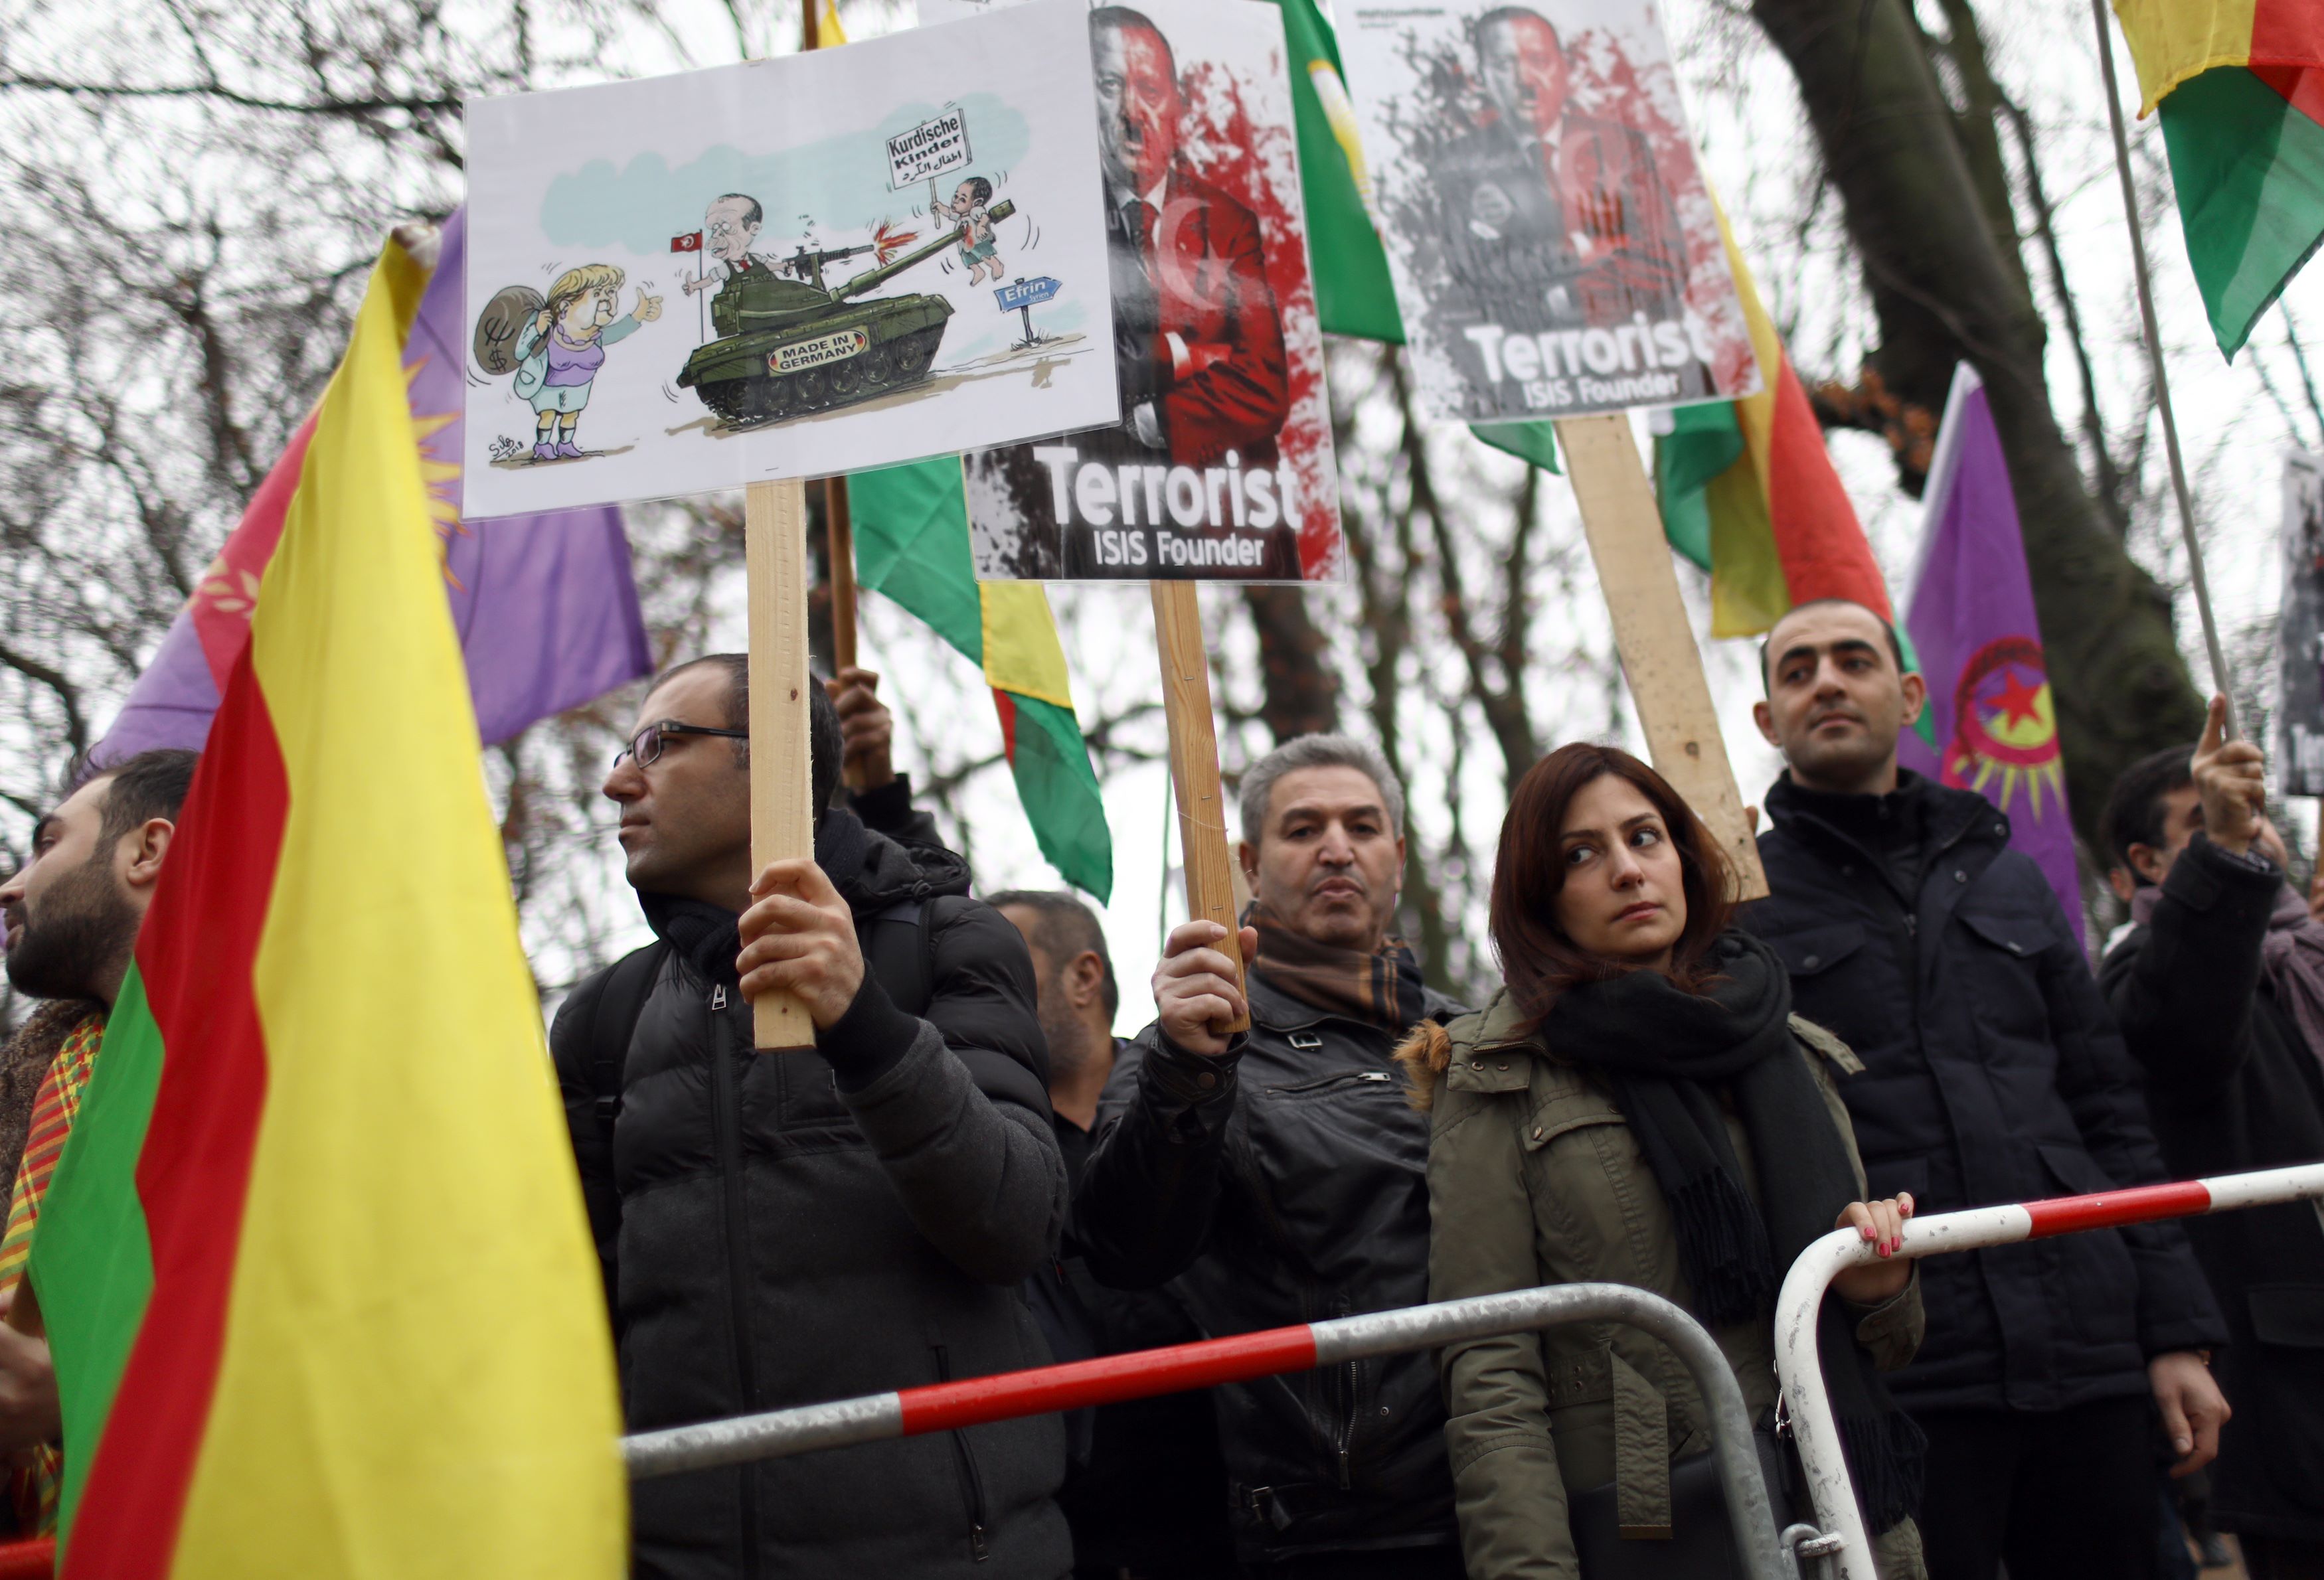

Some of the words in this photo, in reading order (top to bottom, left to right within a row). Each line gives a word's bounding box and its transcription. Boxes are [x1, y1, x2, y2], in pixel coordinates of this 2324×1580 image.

[888, 118, 959, 157] Kurdische
[894, 134, 960, 169] Kinder
[1005, 281, 1046, 302] Efrin
[780, 343, 856, 370] GERMANY
[782, 341, 829, 359] MADE
[832, 335, 849, 347] IN
[1465, 310, 1715, 384] Terrorist
[1523, 378, 1573, 409] ISIS
[1578, 372, 1679, 404] Founder
[505, 441, 524, 458] 2018
[1033, 449, 1303, 530] Terrorist
[1094, 530, 1148, 566] ISIS
[1157, 532, 1264, 567] Founder
